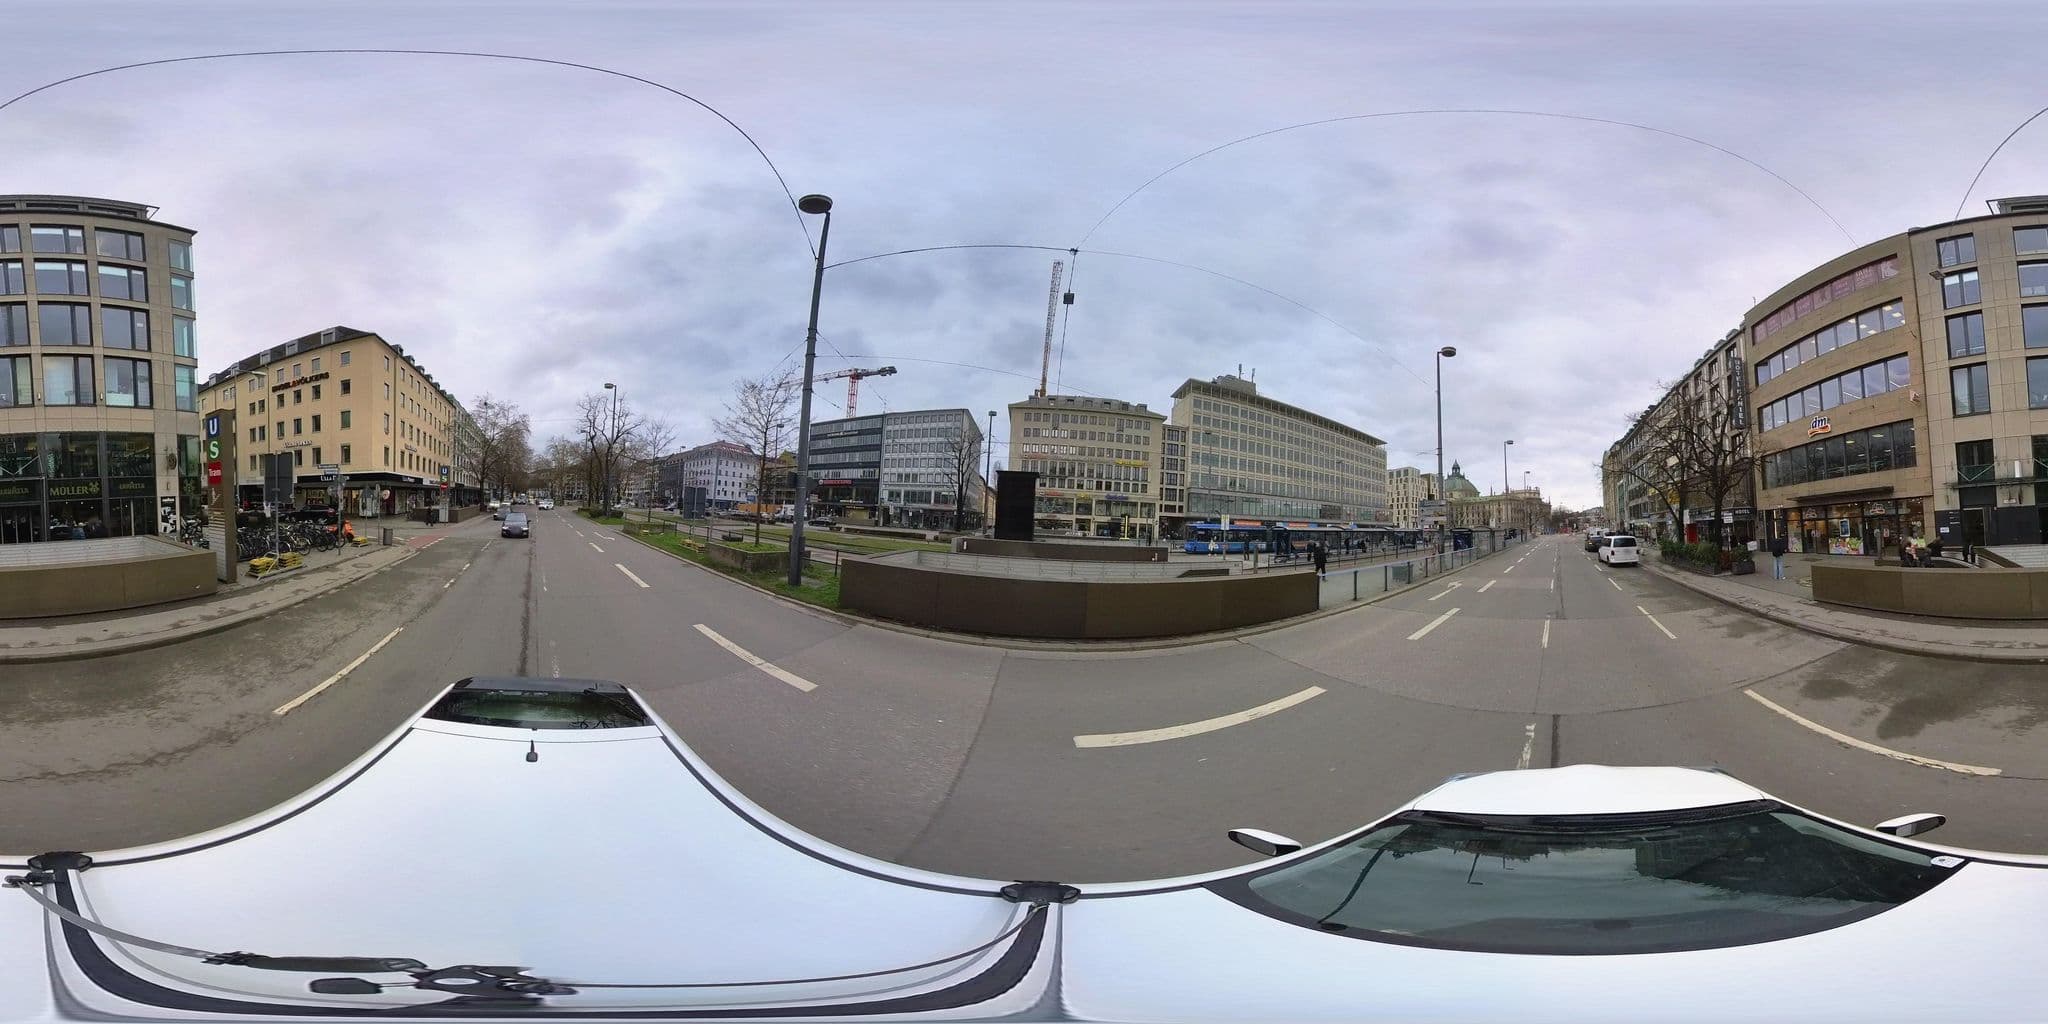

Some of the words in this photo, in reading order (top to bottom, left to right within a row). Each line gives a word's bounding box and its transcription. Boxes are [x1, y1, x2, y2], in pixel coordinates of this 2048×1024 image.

[209, 418, 218, 435] U
[1811, 415, 1828, 430] dm
[209, 441, 219, 459] S
[208, 468, 222, 477] Tram
